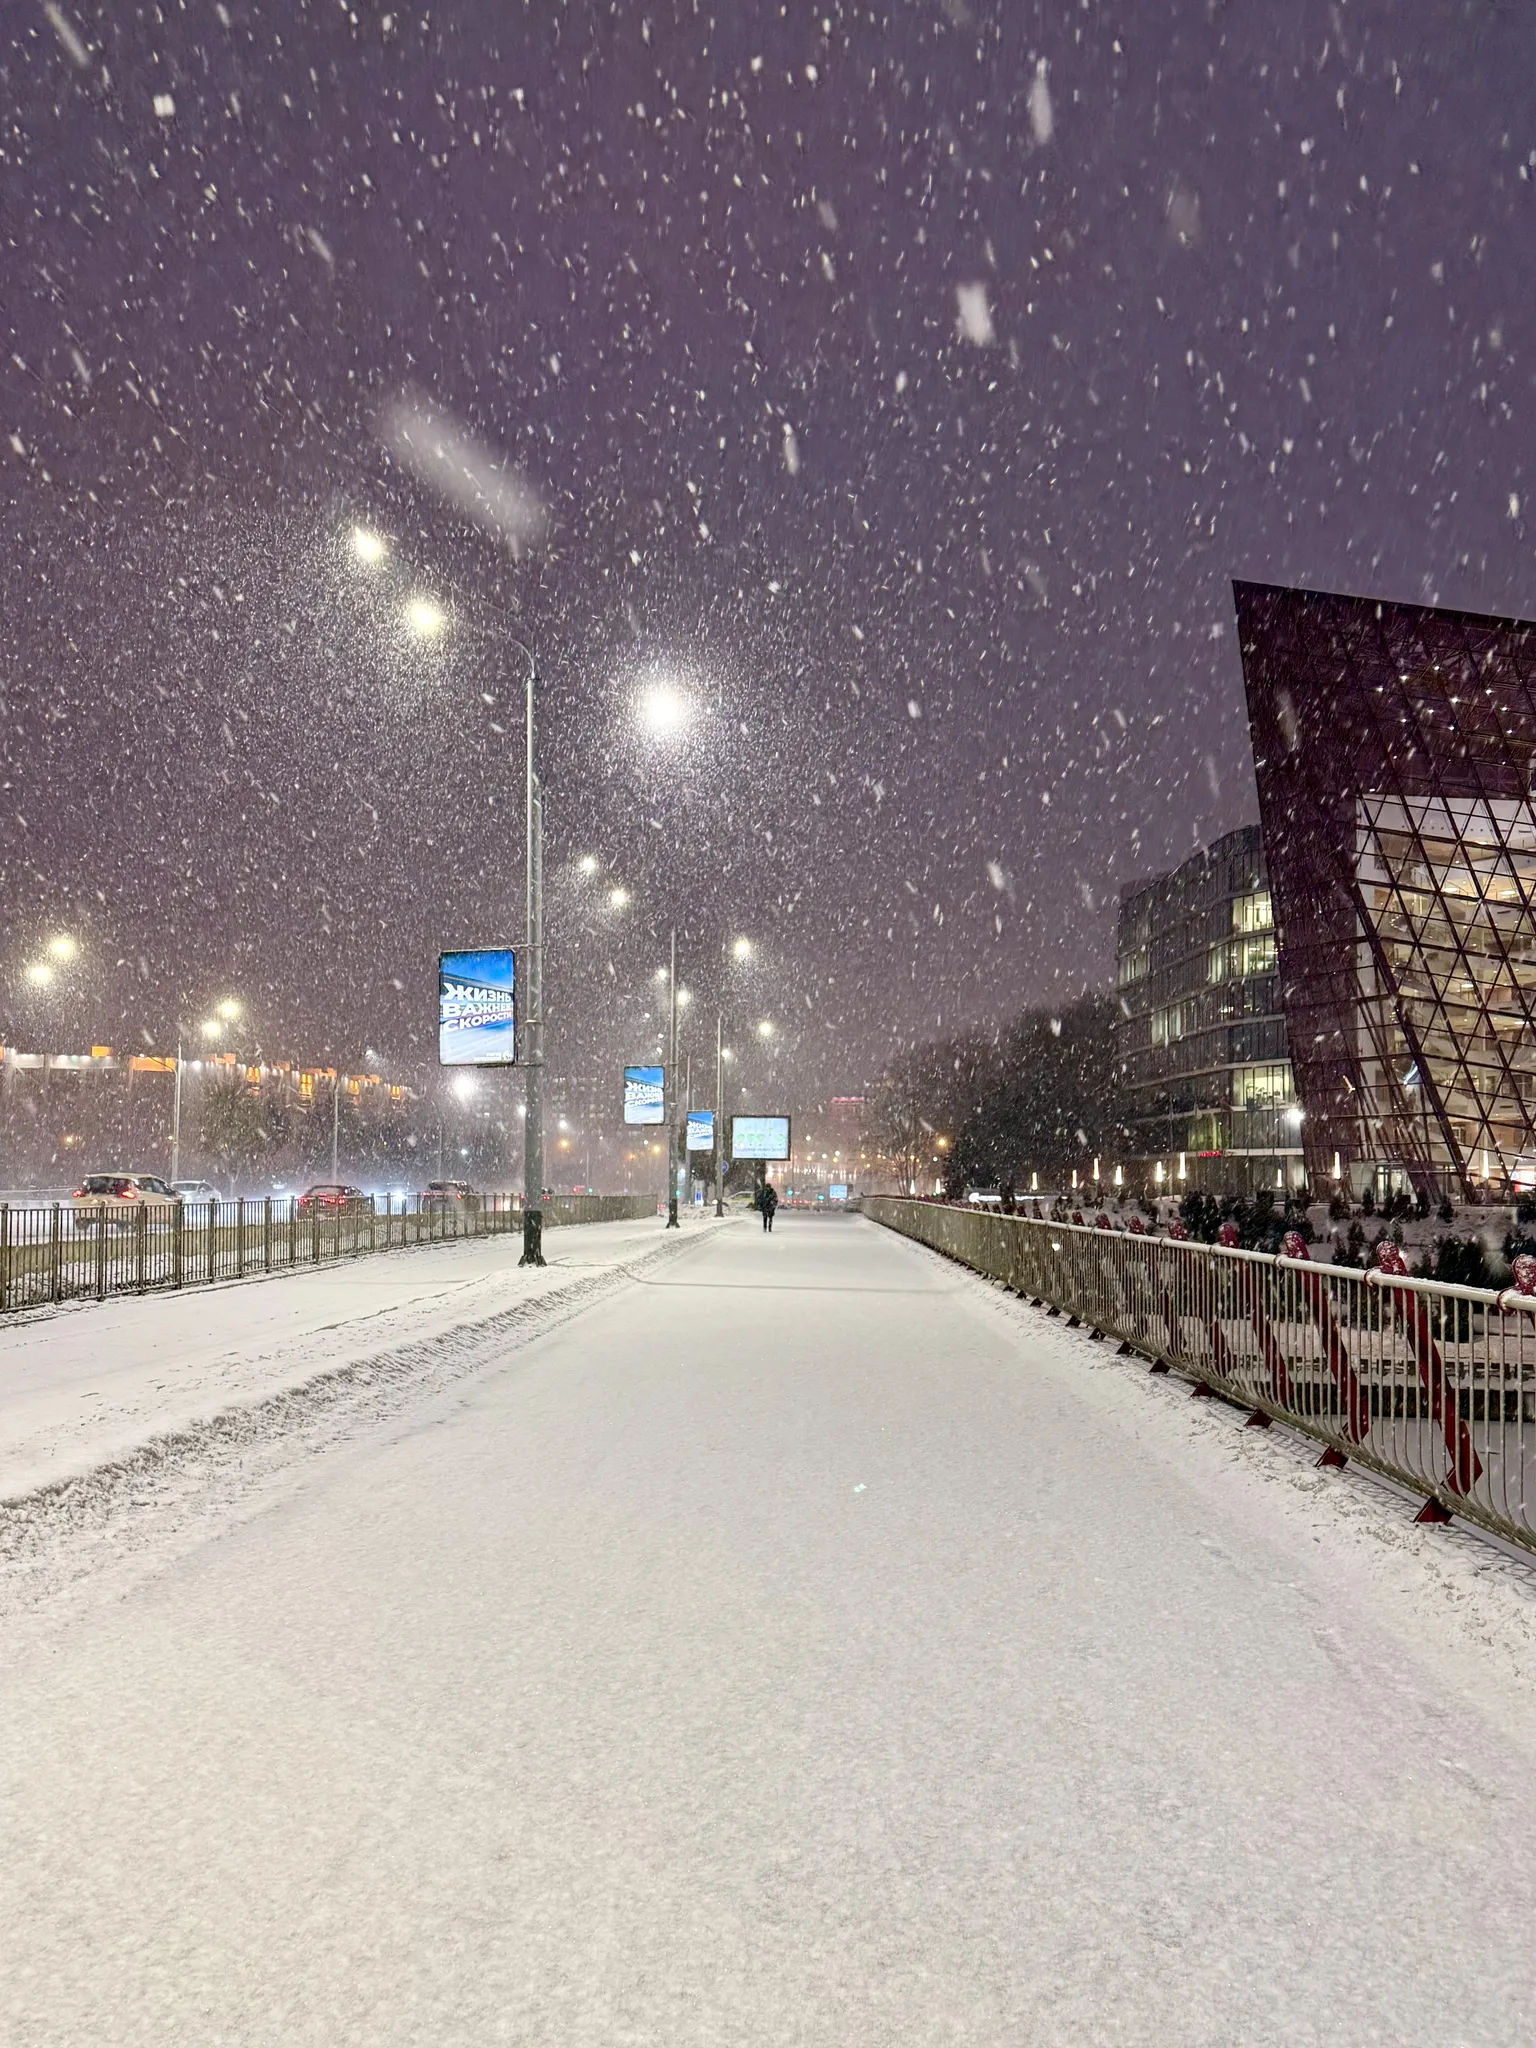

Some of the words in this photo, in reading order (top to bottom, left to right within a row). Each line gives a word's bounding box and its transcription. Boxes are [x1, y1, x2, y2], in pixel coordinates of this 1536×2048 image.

[443, 982, 512, 1002] ЖИЗНЬ
[443, 1003, 512, 1018] ВАЖНЕЕ
[443, 1013, 512, 1030] СКОРОСТИ
